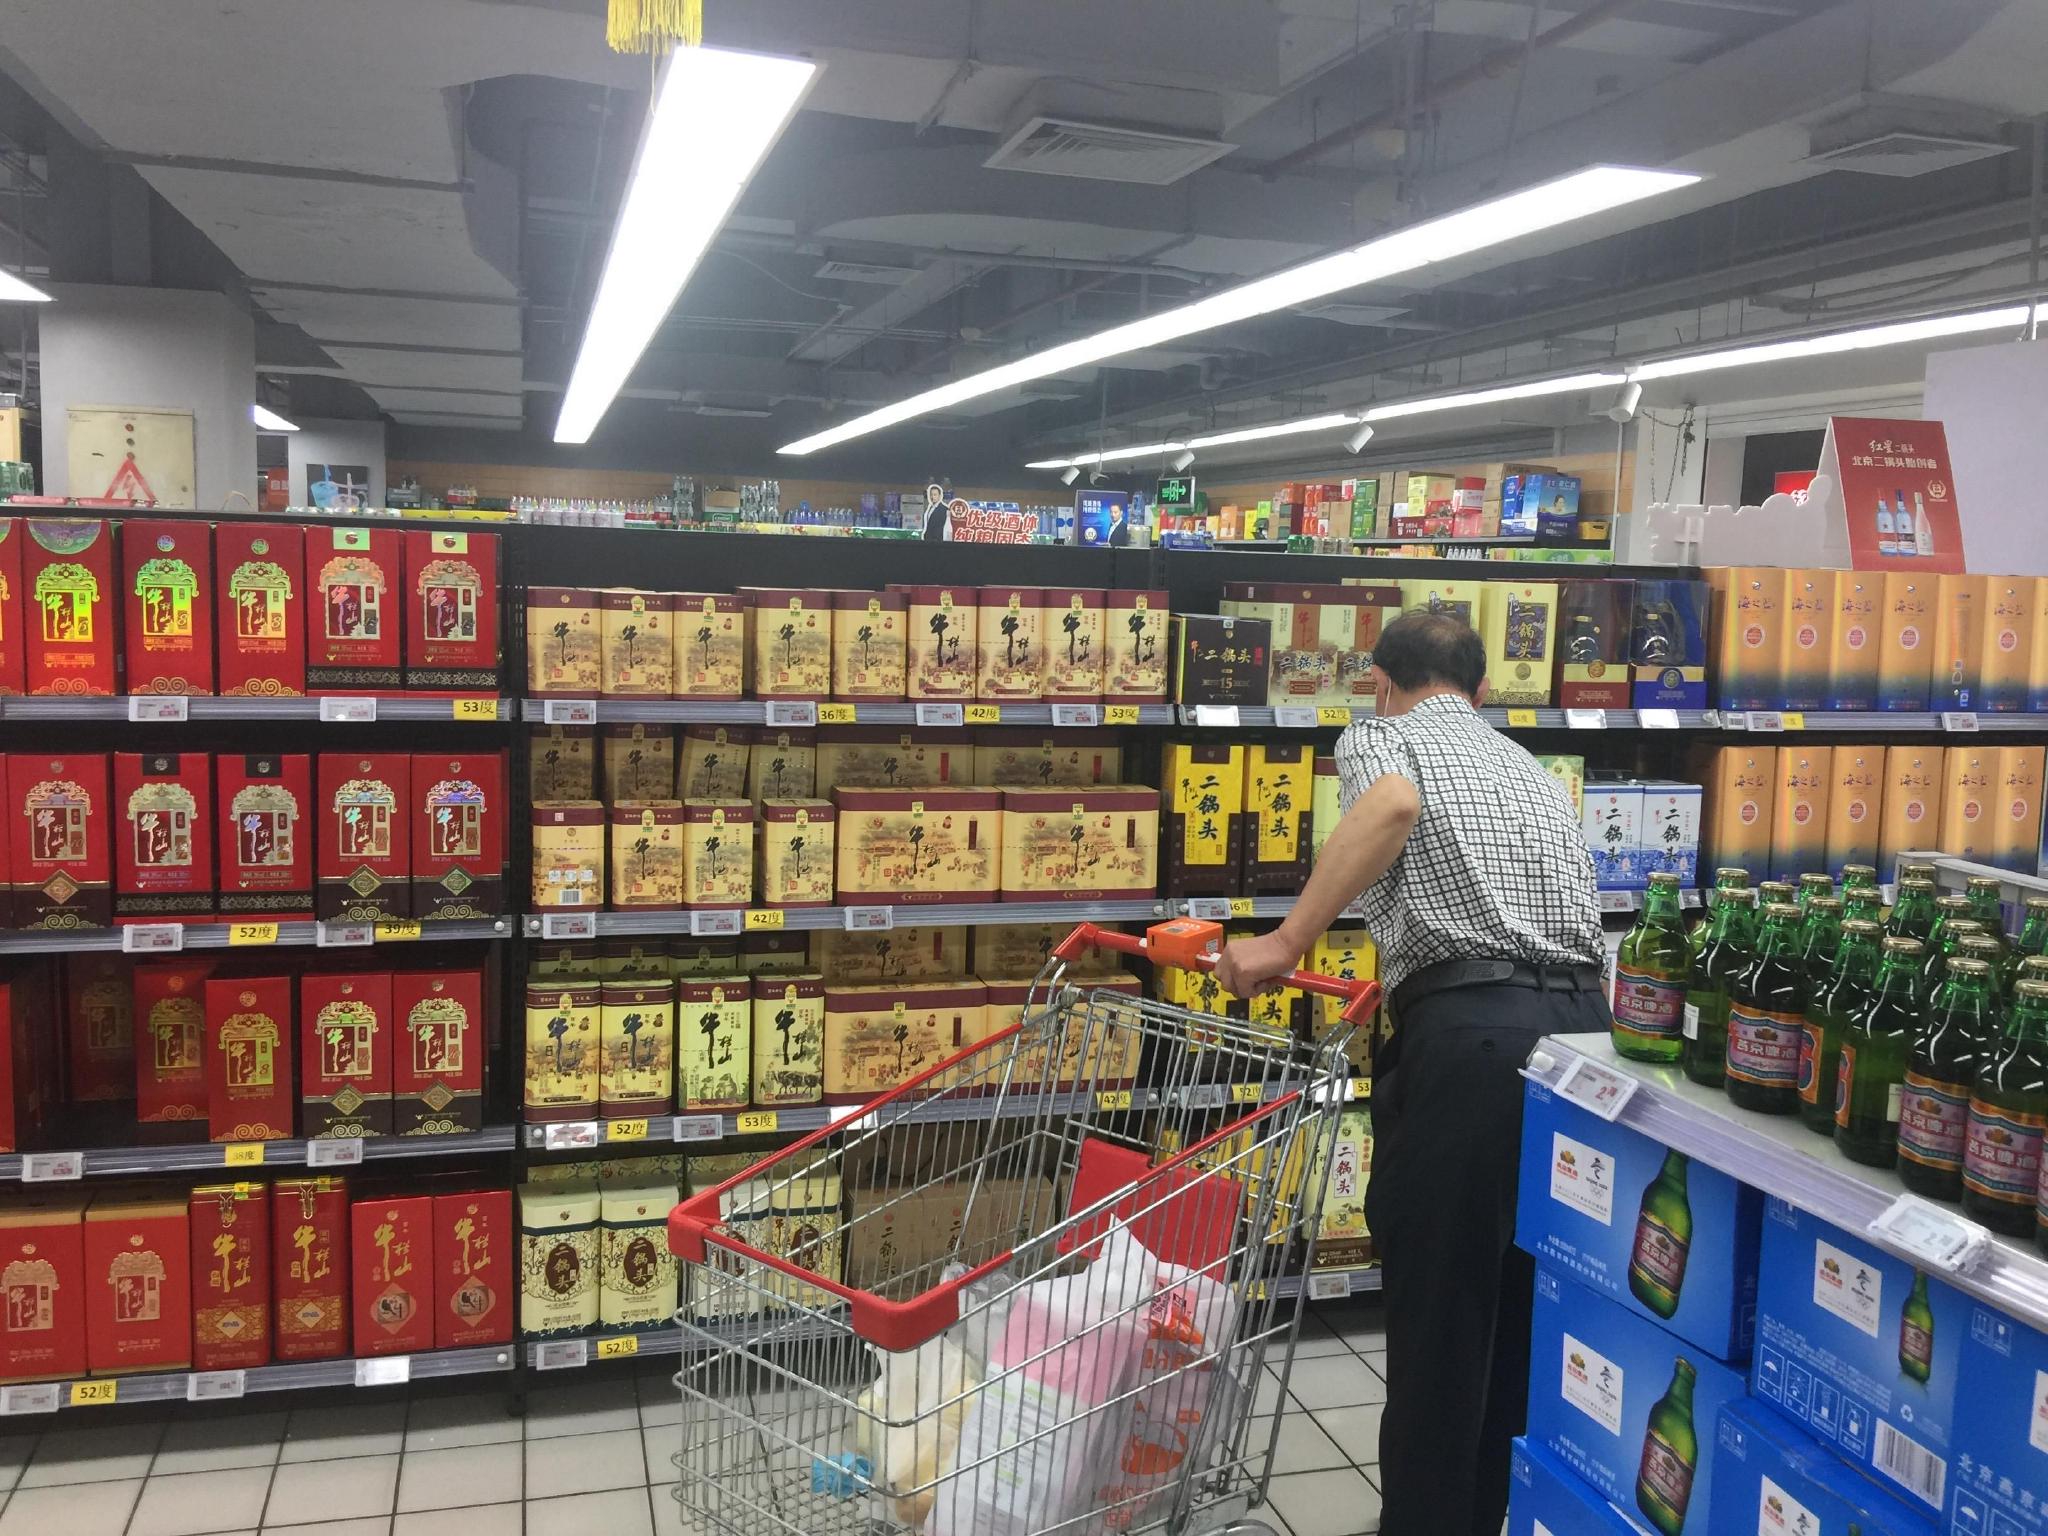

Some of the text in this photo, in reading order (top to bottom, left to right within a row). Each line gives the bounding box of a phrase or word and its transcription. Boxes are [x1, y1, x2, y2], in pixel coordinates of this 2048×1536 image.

[966, 509, 1039, 532] 优级酒体
[930, 613, 959, 667] 牛栏山
[1001, 615, 1029, 668] 牛栏山
[1063, 613, 1090, 665] 牛栏山
[1128, 613, 1155, 665] 牛栏山
[1204, 647, 1251, 663] 二锅头
[1280, 655, 1327, 670] 二锅头
[821, 709, 848, 720] 36度
[1196, 775, 1220, 840] 二锅头
[1269, 774, 1292, 838] 二锅头
[1603, 808, 1622, 863] 二锅头
[1663, 808, 1680, 863] 二锅头
[239, 926, 273, 938] 52度
[753, 912, 780, 925] 42度
[1620, 996, 1673, 1014] 燕京啤酒
[327, 1027, 353, 1072] 牛栏山
[418, 1024, 443, 1069] 牛栏山
[700, 1012, 732, 1069] 牛栏山
[775, 1009, 808, 1066] 牛栏山
[1737, 1039, 1797, 1058] 燕京啤酒
[745, 1114, 773, 1128] 53度
[1903, 1110, 1963, 1137] 燕京啤酒
[1336, 1146, 1353, 1194] 二锅头
[1969, 1138, 2037, 1168] 燕京啤酒
[213, 1233, 251, 1293] 牛栏山
[293, 1225, 330, 1283] 牛栏山
[374, 1223, 412, 1282] 牛栏山
[454, 1218, 490, 1275] 牛栏山
[554, 1246, 571, 1289] 二锅头
[633, 1241, 648, 1281] 二锅头
[1641, 1240, 1679, 1272] 燕京啤酒
[606, 1340, 634, 1354] 52度
[80, 1384, 113, 1399] 52度
